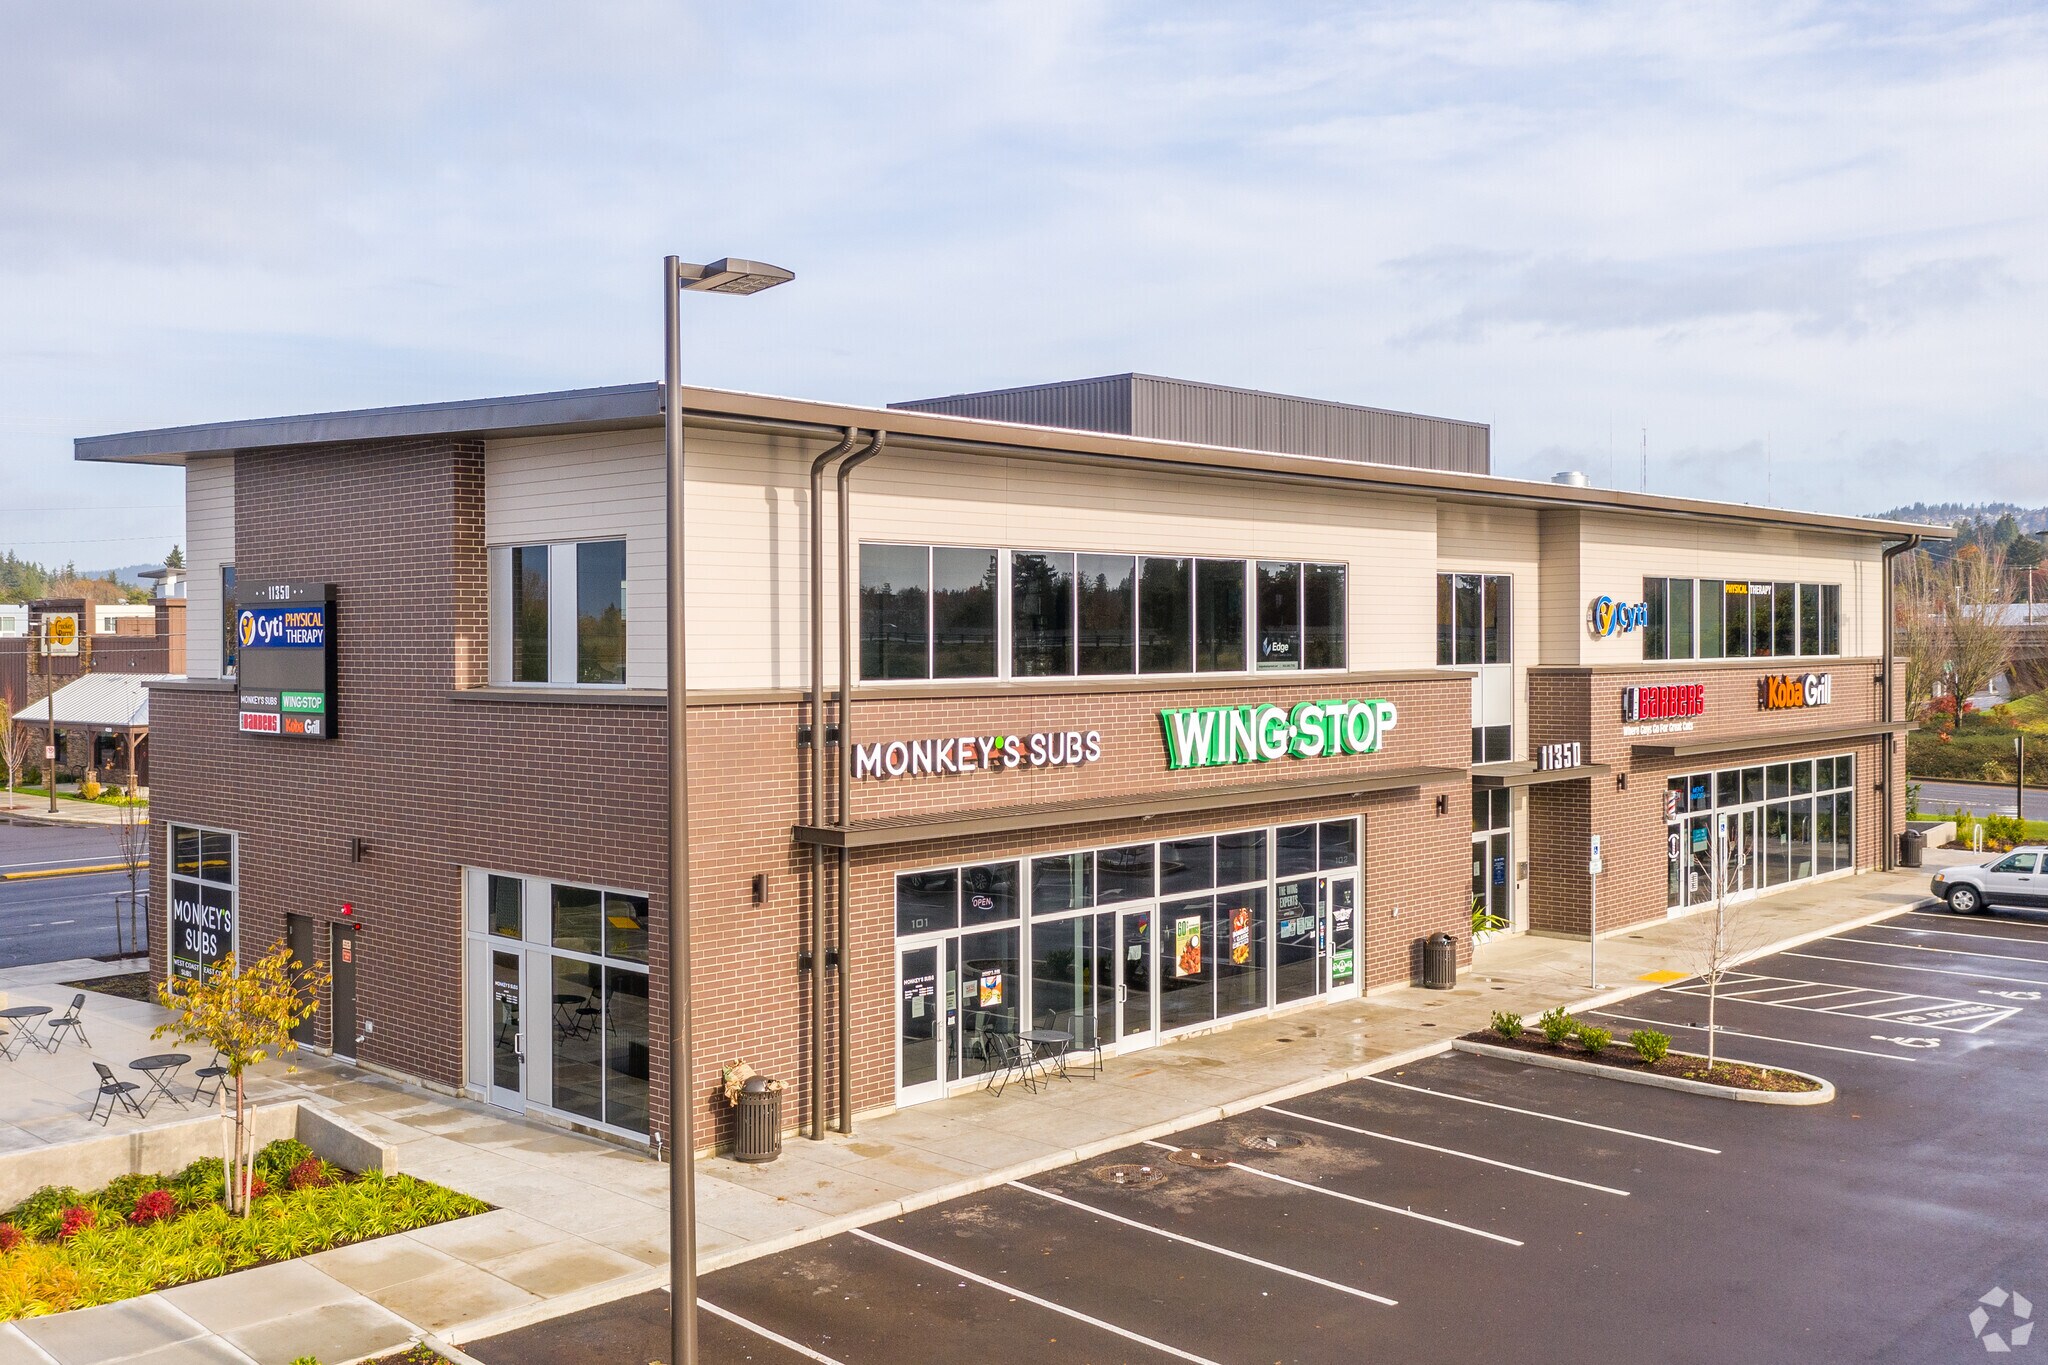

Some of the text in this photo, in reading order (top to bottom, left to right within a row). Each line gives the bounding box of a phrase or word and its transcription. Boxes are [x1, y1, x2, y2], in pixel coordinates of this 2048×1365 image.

[267, 585, 290, 600] 11350
[1725, 584, 1772, 595] PHYSICAL THERAPY
[285, 612, 324, 627] PHYSICAL
[1617, 602, 1648, 633] Cyti
[257, 615, 283, 643] Cyti
[286, 628, 324, 643] THERAPY
[1272, 642, 1289, 653] Edge
[1767, 673, 1832, 709] Koba Grill
[240, 695, 278, 705] MONKEY'S SUBS
[285, 718, 320, 734] Koba Grill
[853, 730, 1101, 779] MONKEY'S SUBS
[1540, 742, 1581, 770] 11350
[972, 897, 992, 907] OPEN
[1279, 895, 1298, 908] EXPERTS
[174, 899, 231, 933] MONKEY'S
[911, 918, 928, 929] 101
[185, 927, 217, 957] SUBS
[173, 958, 199, 972] WEST COAST
[203, 966, 215, 975] EAST
[180, 969, 192, 978] SUBS
